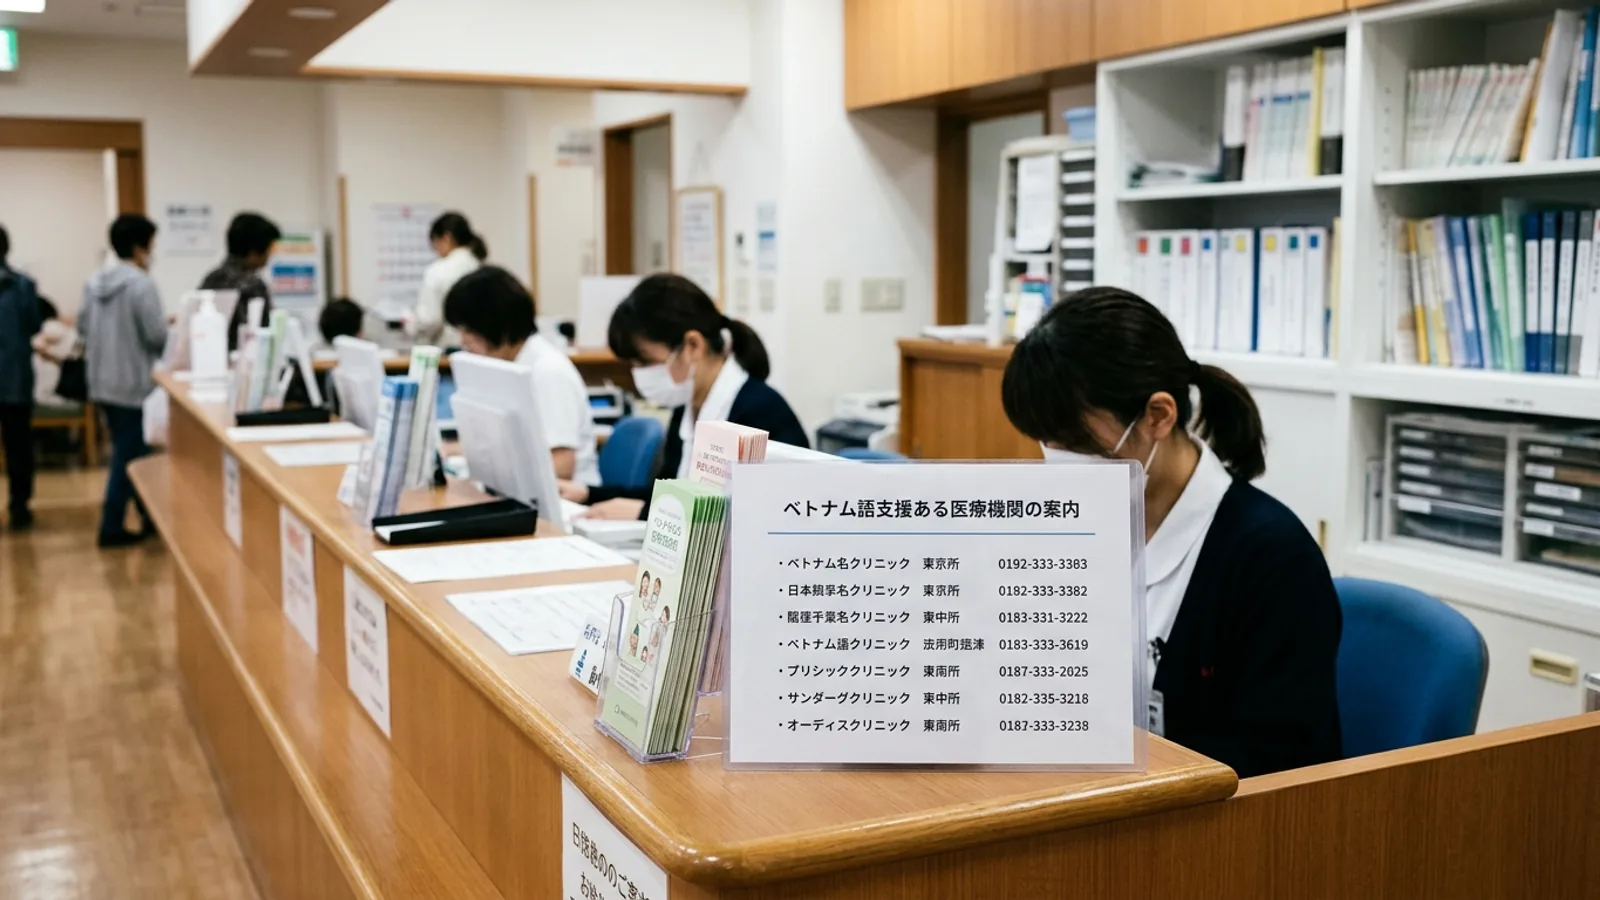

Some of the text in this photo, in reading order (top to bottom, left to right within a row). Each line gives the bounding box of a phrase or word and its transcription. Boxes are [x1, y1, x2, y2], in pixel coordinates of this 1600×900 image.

[998, 557, 1089, 571] 0192-333-3383
[998, 583, 1089, 597] 0182-333-3382
[998, 610, 1089, 624] 0183-331-3222
[998, 637, 1089, 651] 0183-333-3619
[998, 664, 1089, 678] 0187-333-2025
[998, 691, 1089, 705] 0182-335-3218
[998, 718, 1089, 732] 0187-333-3238
